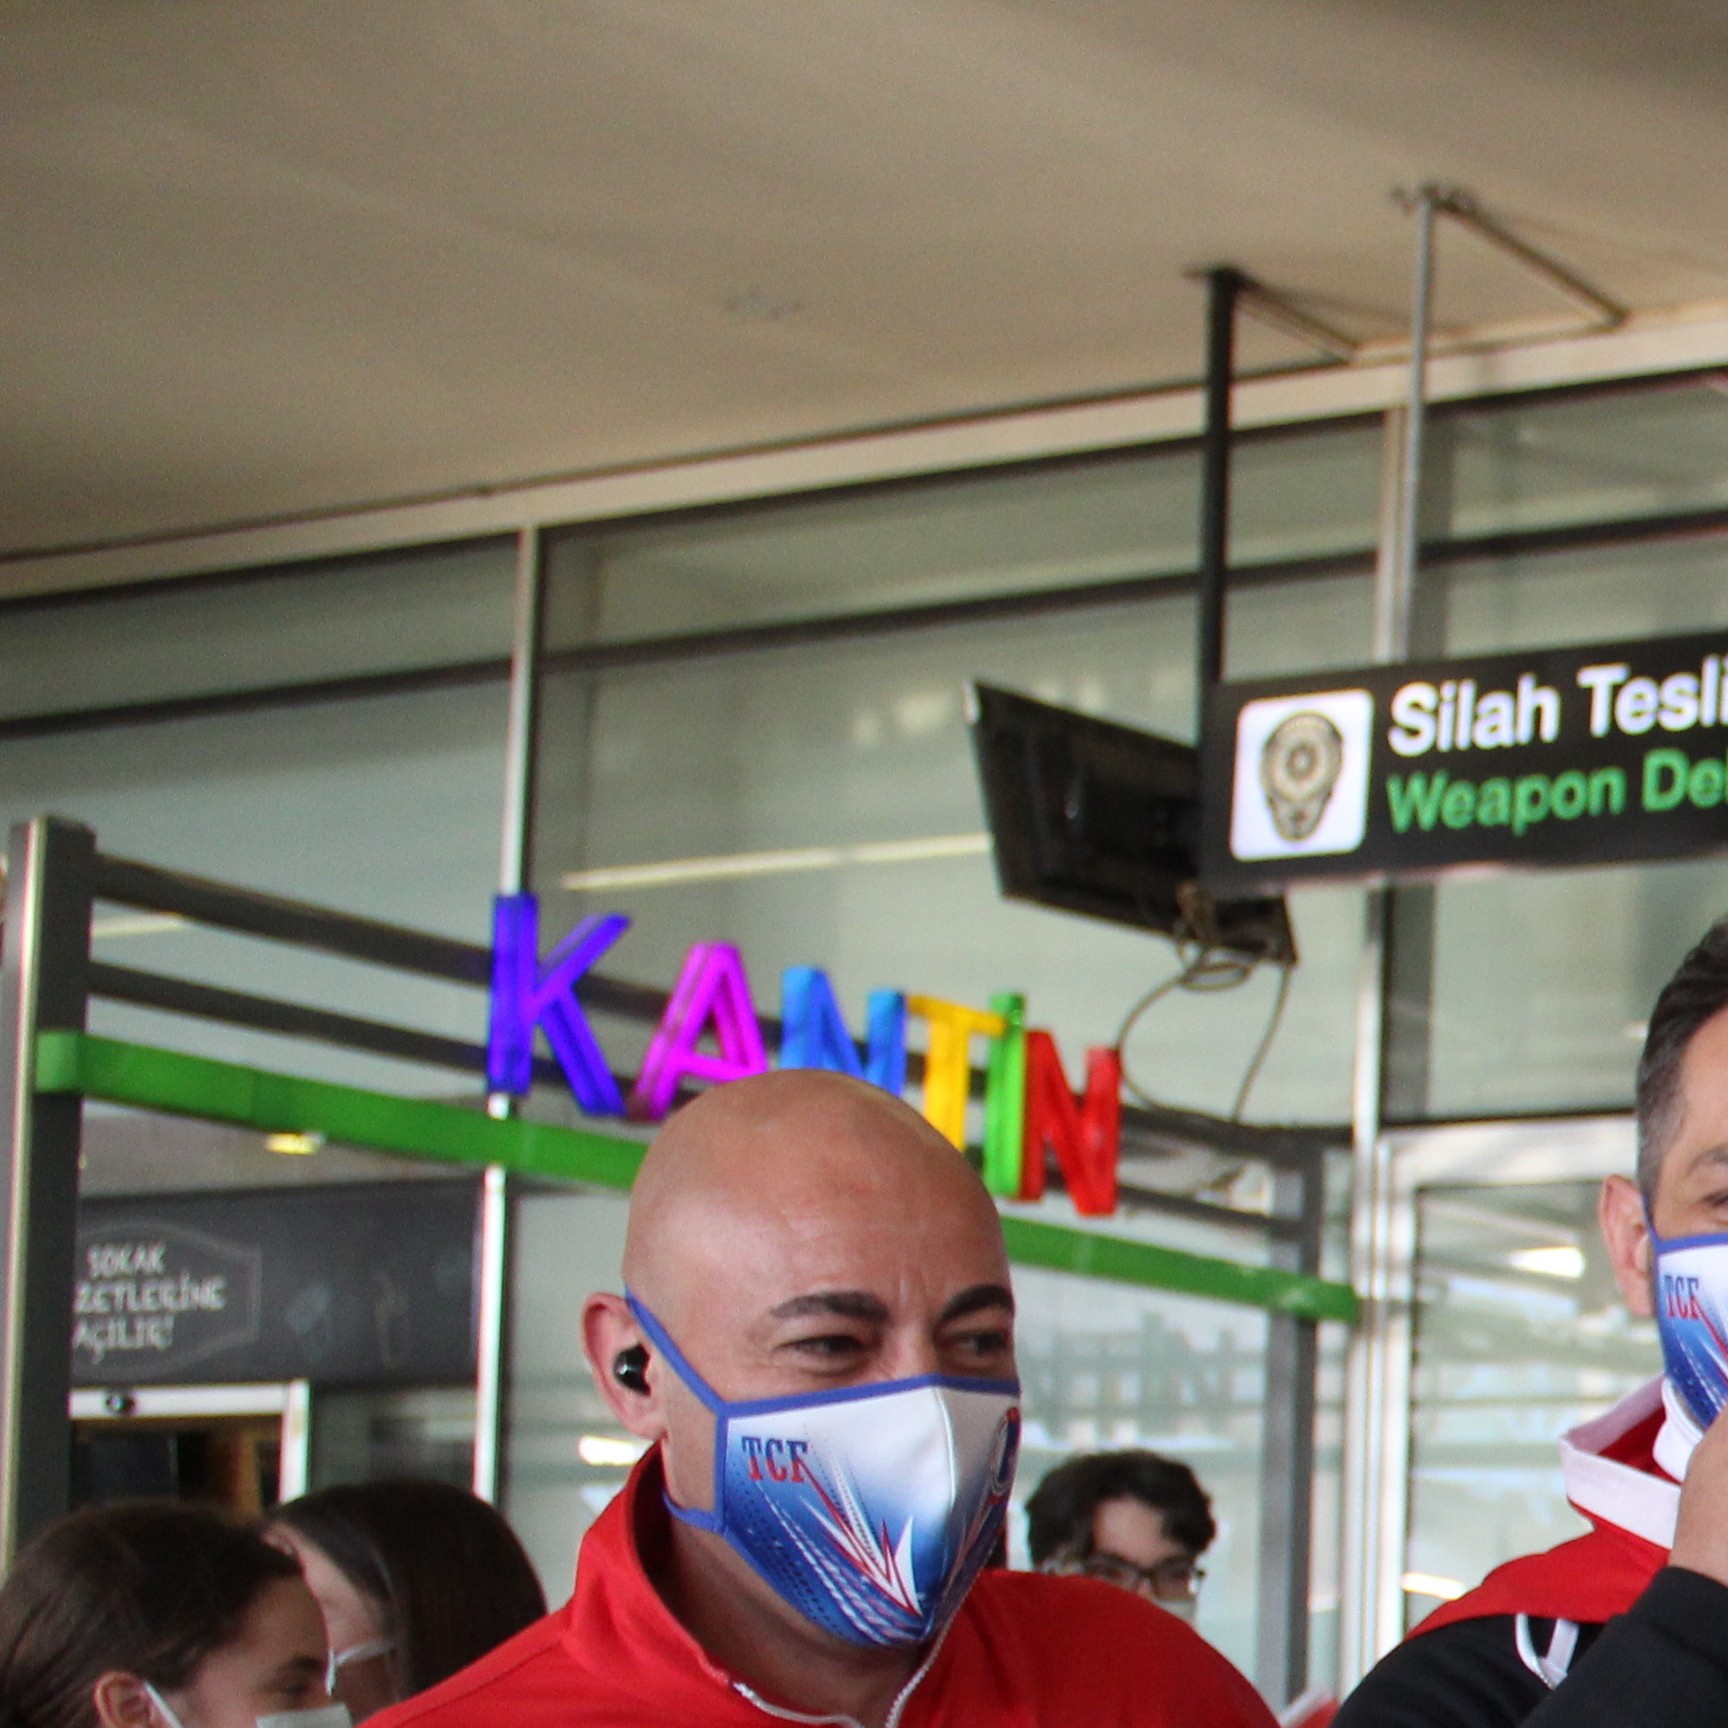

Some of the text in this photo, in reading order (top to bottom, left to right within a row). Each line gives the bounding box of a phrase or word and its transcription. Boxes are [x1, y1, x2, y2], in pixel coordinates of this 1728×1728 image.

[1387, 672, 1562, 758] Silah
[1385, 765, 1627, 837] Weapon
[741, 1436, 808, 1484] TCF
